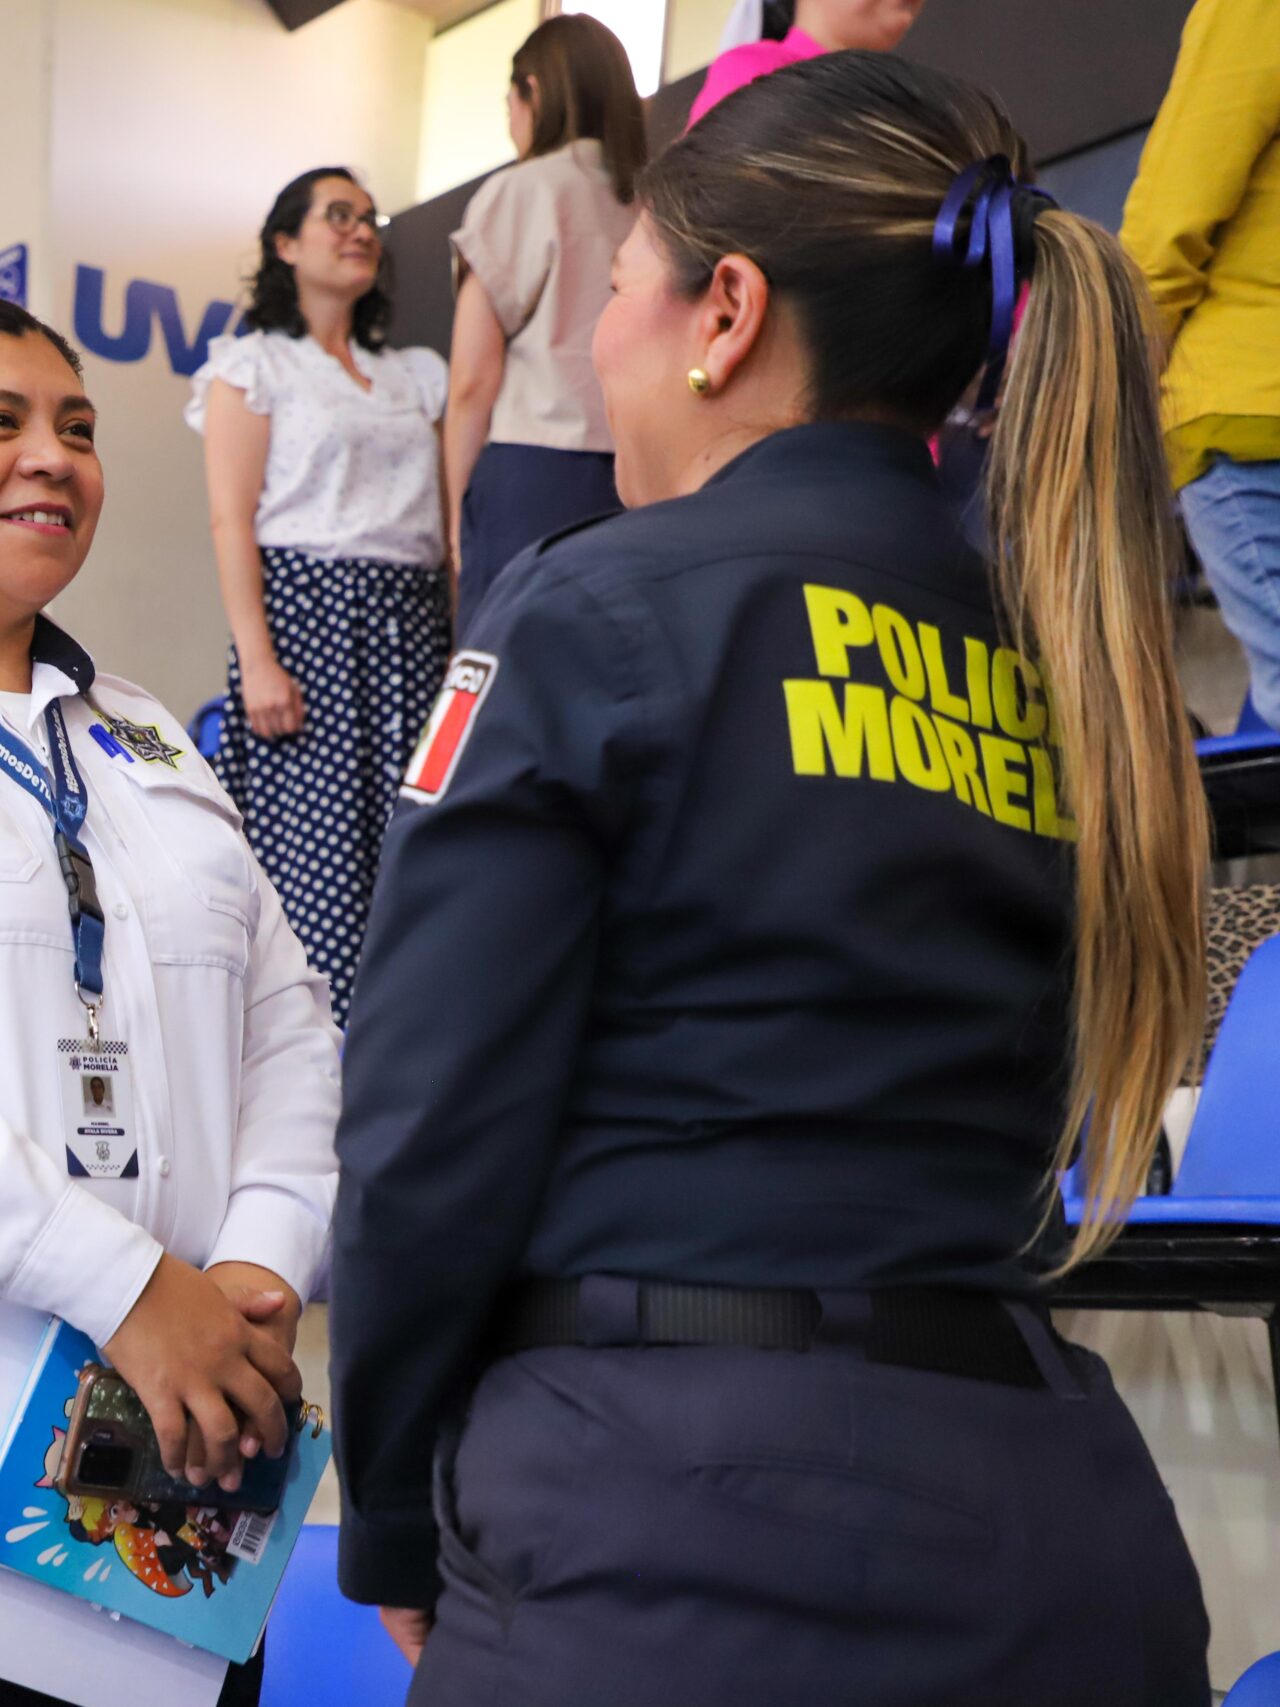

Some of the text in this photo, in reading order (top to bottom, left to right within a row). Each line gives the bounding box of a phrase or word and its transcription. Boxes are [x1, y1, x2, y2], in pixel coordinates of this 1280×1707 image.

[74, 264, 249, 377] UV
[803, 583, 1060, 747] POLIC
[782, 679, 1079, 843] MOREL
[83, 1056, 118, 1064] POLICÍA
